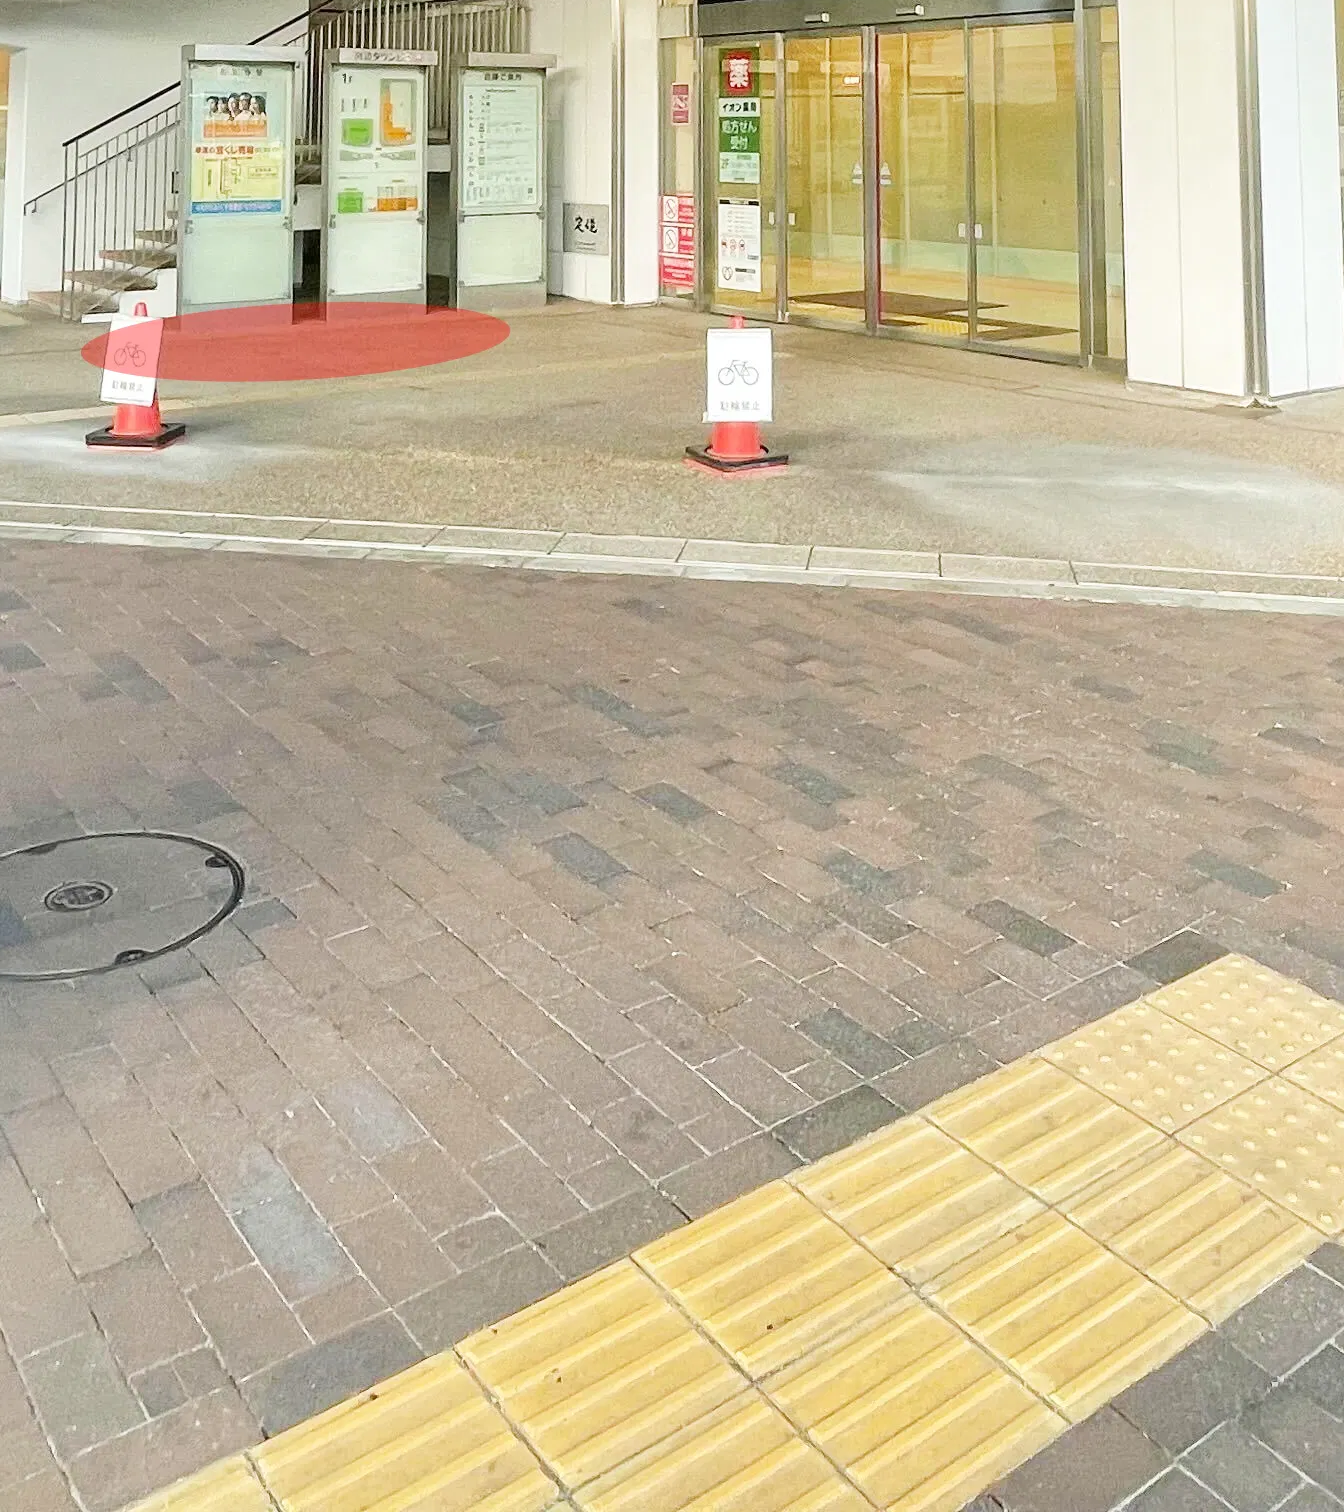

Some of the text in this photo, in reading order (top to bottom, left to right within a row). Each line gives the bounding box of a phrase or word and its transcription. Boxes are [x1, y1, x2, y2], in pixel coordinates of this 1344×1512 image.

[722, 120, 757, 133] 処方せん
[730, 136, 748, 150] 受付
